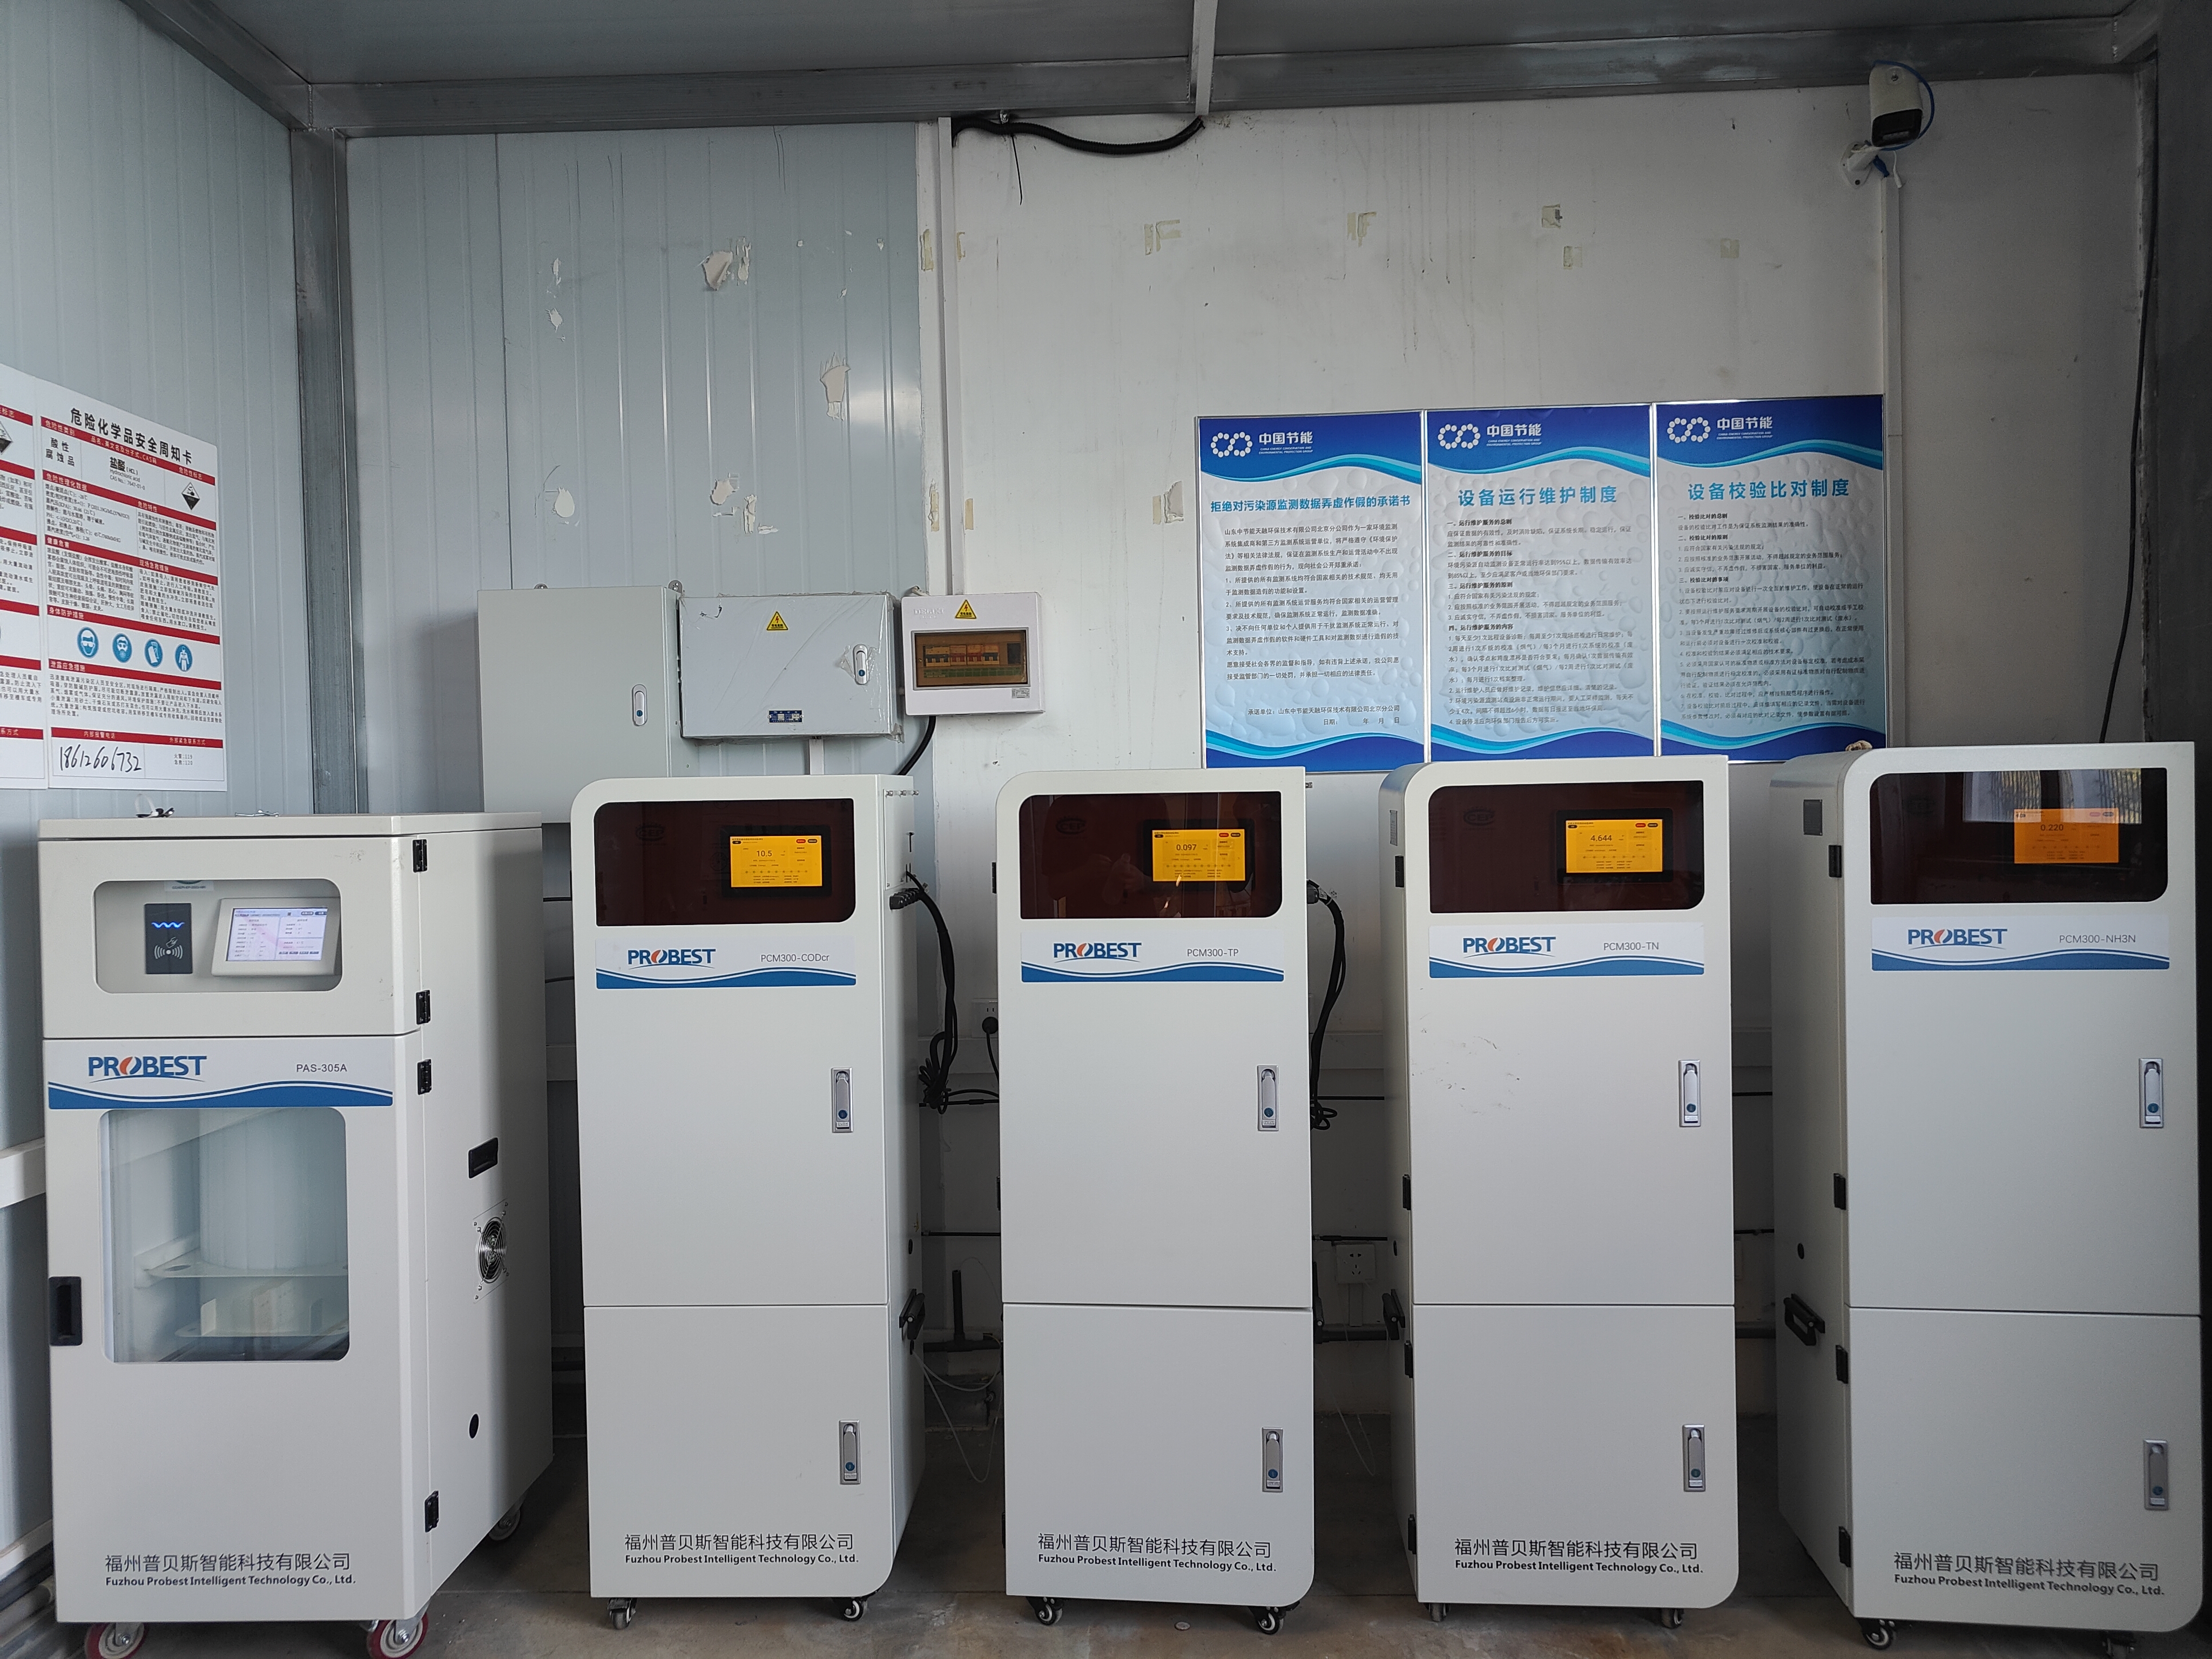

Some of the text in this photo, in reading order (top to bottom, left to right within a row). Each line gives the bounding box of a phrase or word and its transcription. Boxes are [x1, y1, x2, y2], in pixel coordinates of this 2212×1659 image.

[1487, 423, 1542, 437] 中国节能
[1717, 416, 1772, 430] 中国节能
[70, 407, 192, 465] 危险化学品安全周知卡
[1259, 431, 1313, 445] 中国节能
[179, 467, 203, 480] 危险性标志
[1458, 485, 1617, 507] 设备运行维护制度
[1688, 478, 1849, 501] 设备校验比对制度
[138, 501, 158, 512] 危险特性
[1211, 495, 1411, 512] 拒绝对污染源监测数据弄虚作假的承诺书
[139, 559, 169, 572] 现场急救措施
[49, 607, 84, 619] 身体防护措施
[60, 744, 142, 773] 18612606732
[1463, 936, 1556, 953] PROBEST
[1908, 929, 2007, 945] PROBEST
[2059, 935, 2136, 944] PCM300-NH3N
[1054, 942, 1142, 958] PROBEST
[1187, 948, 1239, 957] PCM300-TP
[1603, 942, 1659, 950] PCM300-TN
[628, 949, 716, 965] PROBEST
[760, 954, 830, 963] PCM300-CODcr
[89, 1056, 207, 1076] PROBEST
[296, 1063, 348, 1073] PAS-305A
[624, 1534, 854, 1552] 福州普贝斯智能科技有限公司
[1037, 1533, 1271, 1558] 福州普贝斯智能科技有限公司
[1454, 1539, 1698, 1560] 福州普贝斯智能科技有限公司
[105, 1553, 351, 1573] 福州普贝斯智能科技有限公司
[625, 1554, 859, 1565] Fuzhou Probest Intelligent Technology Co., Ltd.
[1038, 1554, 1277, 1572] Fuzhou Probest Intelligent Technology Co., Ltd.
[1455, 1560, 1703, 1574] Fuzhou Probest Intelligent Technology Co., Ltd.
[1893, 1552, 2159, 1581] 福州普贝斯智能科技有限公司
[105, 1574, 356, 1588] Fuzhou Probest Intelligent Technology Co., Ltd.
[1894, 1574, 2164, 1595] Fuzhou Probest Intelligent Technology Co., Ltd.
